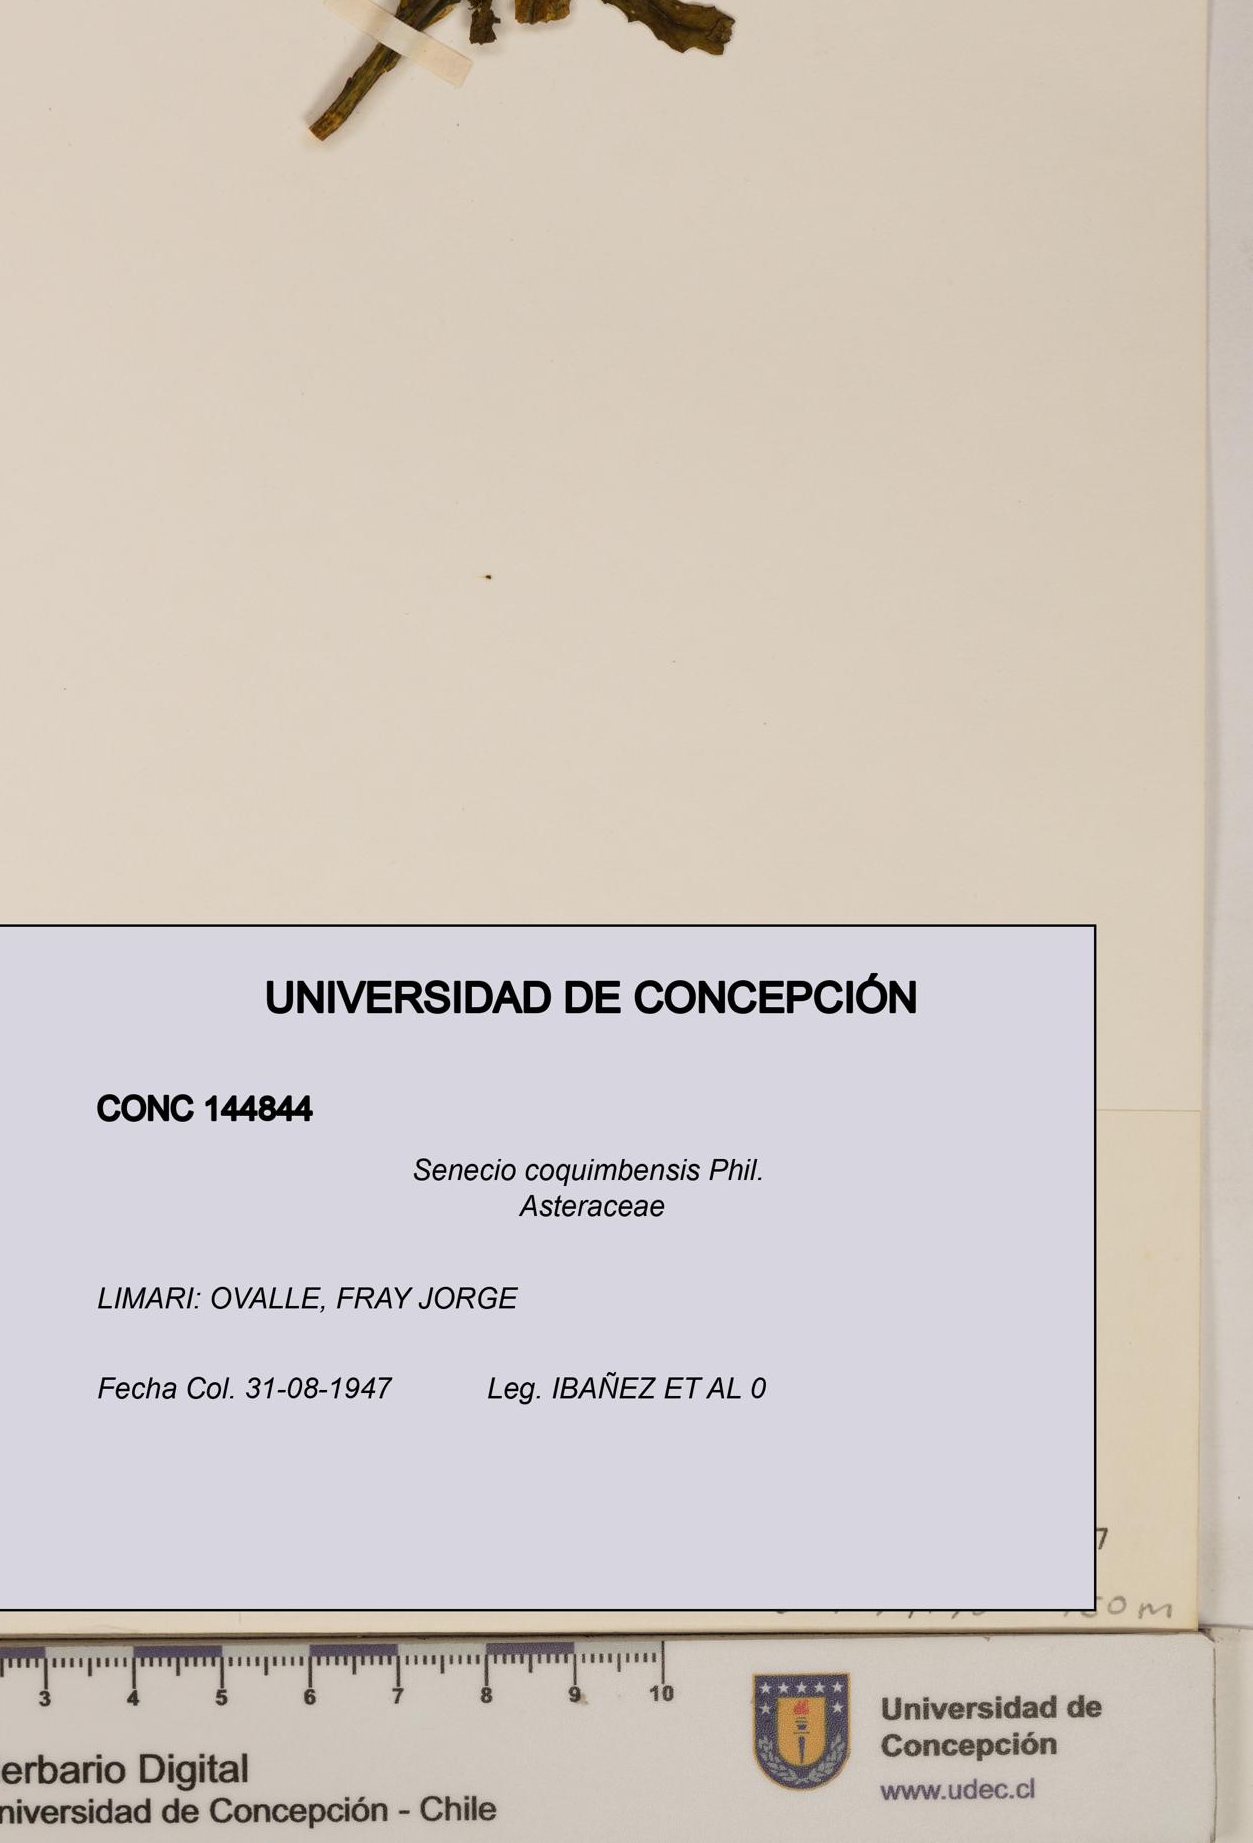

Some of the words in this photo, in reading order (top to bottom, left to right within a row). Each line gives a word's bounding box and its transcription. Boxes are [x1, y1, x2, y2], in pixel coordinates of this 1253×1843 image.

[38, 1688, 52, 1707] 3
[126, 1689, 140, 1707] 4
[215, 1688, 228, 1707] 5
[303, 1686, 317, 1706] 6
[391, 1687, 405, 1705] 7
[480, 1686, 493, 1704] 8
[568, 1685, 582, 1704] 9
[649, 1684, 674, 1702] 10
[881, 1694, 1058, 1721] Universidad
[1066, 1694, 1103, 1719] de
[880, 1731, 1058, 1762] Concepción
[139, 1752, 248, 1792] Digital
[880, 1777, 1035, 1801] www.udec.cl
[161, 1797, 200, 1824] de
[209, 1796, 388, 1829] Concepción
[419, 1795, 497, 1822] Chile
